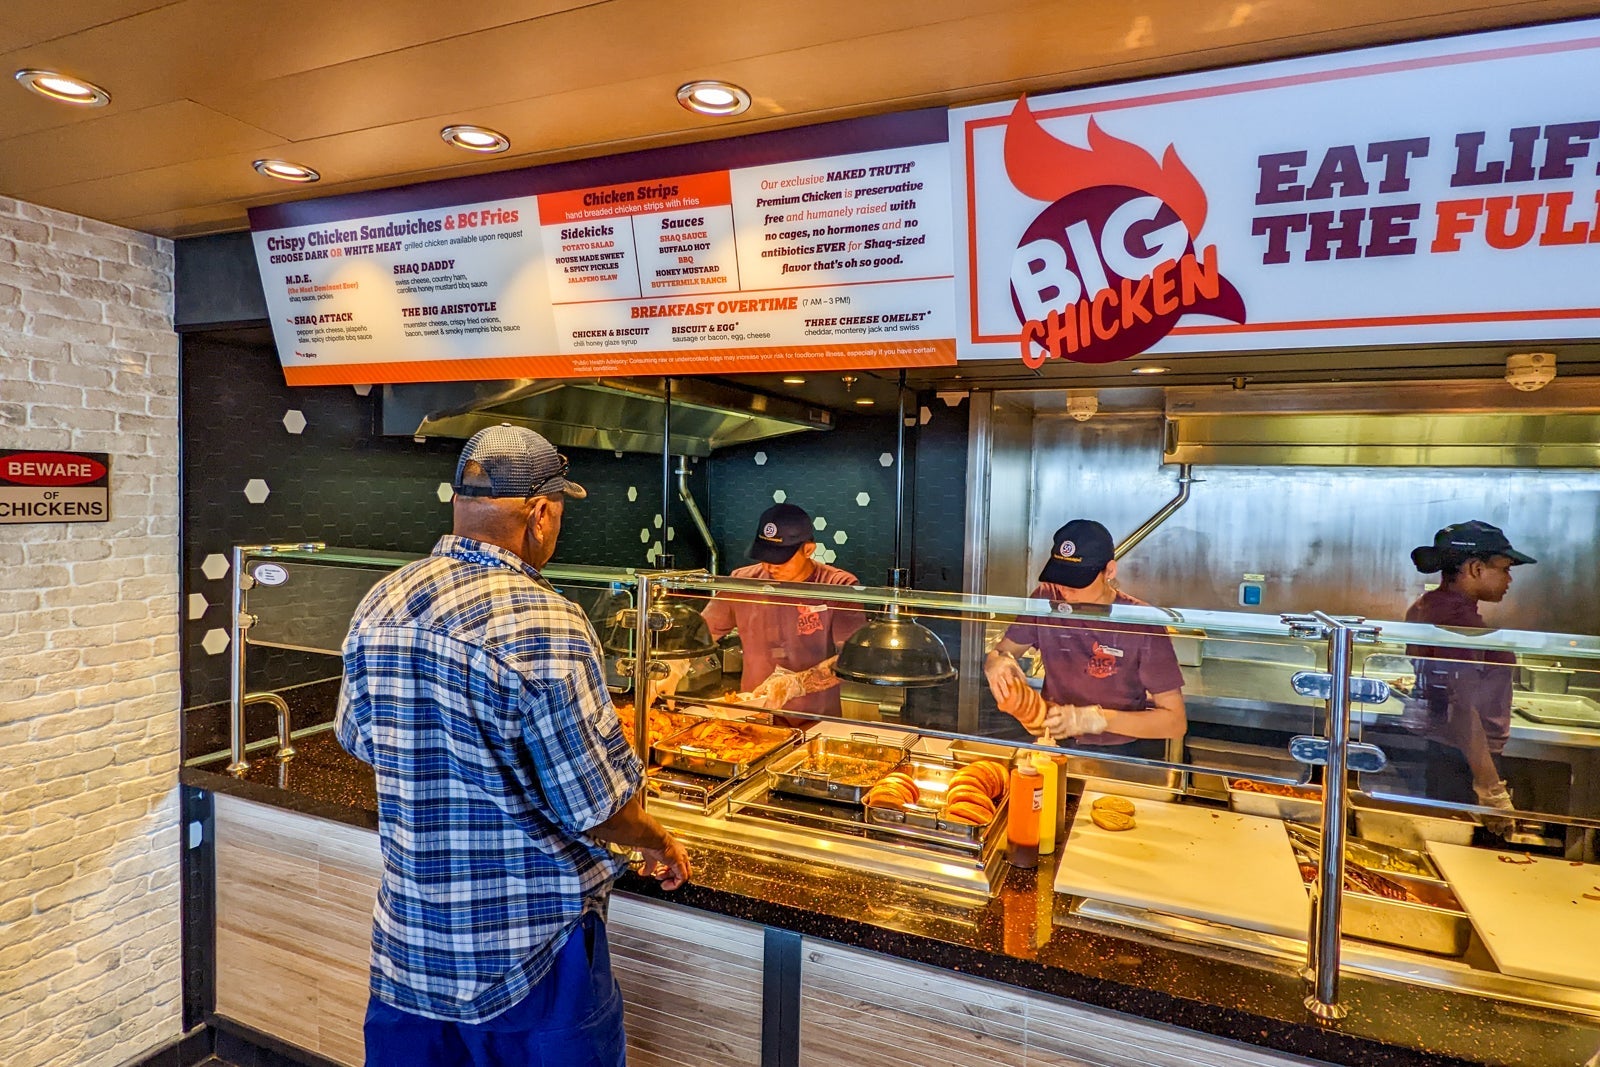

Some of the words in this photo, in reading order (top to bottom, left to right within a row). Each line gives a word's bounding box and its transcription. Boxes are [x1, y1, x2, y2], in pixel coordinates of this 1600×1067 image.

[1255, 137, 1430, 205] EAT
[1450, 120, 1600, 187] LIF
[761, 180, 778, 190] Our
[781, 175, 824, 187] exclusive
[827, 169, 866, 182] NAKED
[584, 189, 634, 206] Chicken
[637, 184, 678, 200] Strips
[756, 194, 800, 208] Premium
[802, 191, 842, 203] Chicken
[844, 189, 852, 198] is
[854, 181, 923, 198] preservative
[565, 211, 582, 220] hand
[584, 207, 613, 218] breaded
[615, 205, 641, 214] chicken
[644, 202, 663, 213] strips
[666, 200, 681, 208] with
[683, 197, 699, 206] fries
[764, 214, 784, 225] free
[786, 211, 803, 222] and
[806, 207, 853, 219] humanely
[856, 203, 887, 215] raised
[890, 199, 916, 211] with
[268, 235, 305, 251] Crispy
[308, 229, 357, 246] Chicken
[360, 218, 441, 240] Sandwiches
[444, 216, 454, 230] &
[458, 212, 477, 229] BC
[481, 209, 518, 225] Fries
[661, 217, 704, 230] Sauces
[779, 230, 810, 241] cages,
[813, 228, 825, 236] no
[827, 222, 879, 235] hormones
[882, 219, 901, 230] and
[904, 219, 918, 228] no
[1252, 203, 1420, 265] THE
[1431, 190, 1600, 253] FUL
[561, 225, 614, 240] Sidekicks
[660, 234, 681, 242] SHAQ
[682, 232, 707, 240] SAUCE
[270, 253, 303, 264] CHOOSE
[305, 250, 328, 260] DARK
[331, 249, 342, 257] OR
[345, 244, 373, 256] WHITE
[376, 242, 401, 252] MEAT
[404, 242, 422, 251] grilled
[425, 239, 448, 248] chicken
[450, 236, 477, 245] available
[479, 234, 495, 242] upon
[497, 230, 522, 240] request
[562, 243, 589, 251] POTATO
[591, 241, 614, 249] SALAD
[659, 245, 692, 254] BUFFALO
[694, 243, 710, 251] HOT
[761, 245, 815, 258] antibiotics
[816, 242, 845, 253] EVER
[847, 241, 861, 252] for
[864, 234, 925, 250] Shaq-sized
[556, 256, 578, 264] HOUSE
[600, 252, 624, 260] SWEET
[781, 263, 811, 274] flavor
[814, 259, 843, 270] that's
[845, 258, 857, 268] oh
[859, 258, 871, 266] so
[874, 255, 903, 266] good.
[1010, 196, 1189, 321] BIG
[394, 264, 419, 274] SHAQ
[421, 260, 455, 271] DADDY
[590, 263, 619, 271] PICKLES
[682, 266, 719, 274] MUSTARD
[286, 274, 311, 284] M.D.E.
[432, 276, 452, 284] country
[453, 273, 467, 281] ham,
[651, 280, 699, 288] BUTTERMILK
[700, 277, 727, 285] RANCH
[397, 286, 417, 294] carolina
[418, 285, 434, 293] honey
[435, 283, 457, 291] mustard
[459, 282, 470, 290] bbq
[402, 308, 420, 317] THE
[423, 306, 438, 316] BIG
[441, 302, 496, 314] ARISTOTLE
[631, 302, 715, 319] BREAKFAST
[717, 297, 798, 314] OVERTIME
[803, 299, 808, 307] (7
[1020, 244, 1220, 369] CHICKEN
[295, 316, 316, 325] SHAQ
[319, 313, 352, 323] ATTACK
[805, 318, 837, 327] THREE
[839, 316, 879, 324] CHEESE
[446, 326, 463, 335] smoky
[464, 325, 490, 333] memphis
[491, 324, 502, 332] bbq
[573, 330, 607, 338] CHICKEN
[616, 328, 649, 336] BISCUIT
[672, 326, 707, 334] BISCUIT
[805, 328, 833, 336] cheddar,
[835, 327, 866, 335] monterey
[868, 326, 882, 334] jack
[346, 333, 356, 341] bbq
[605, 339, 620, 347] glaze
[8, 462, 92, 477] BEWARE
[799, 615, 816, 627] BIG
